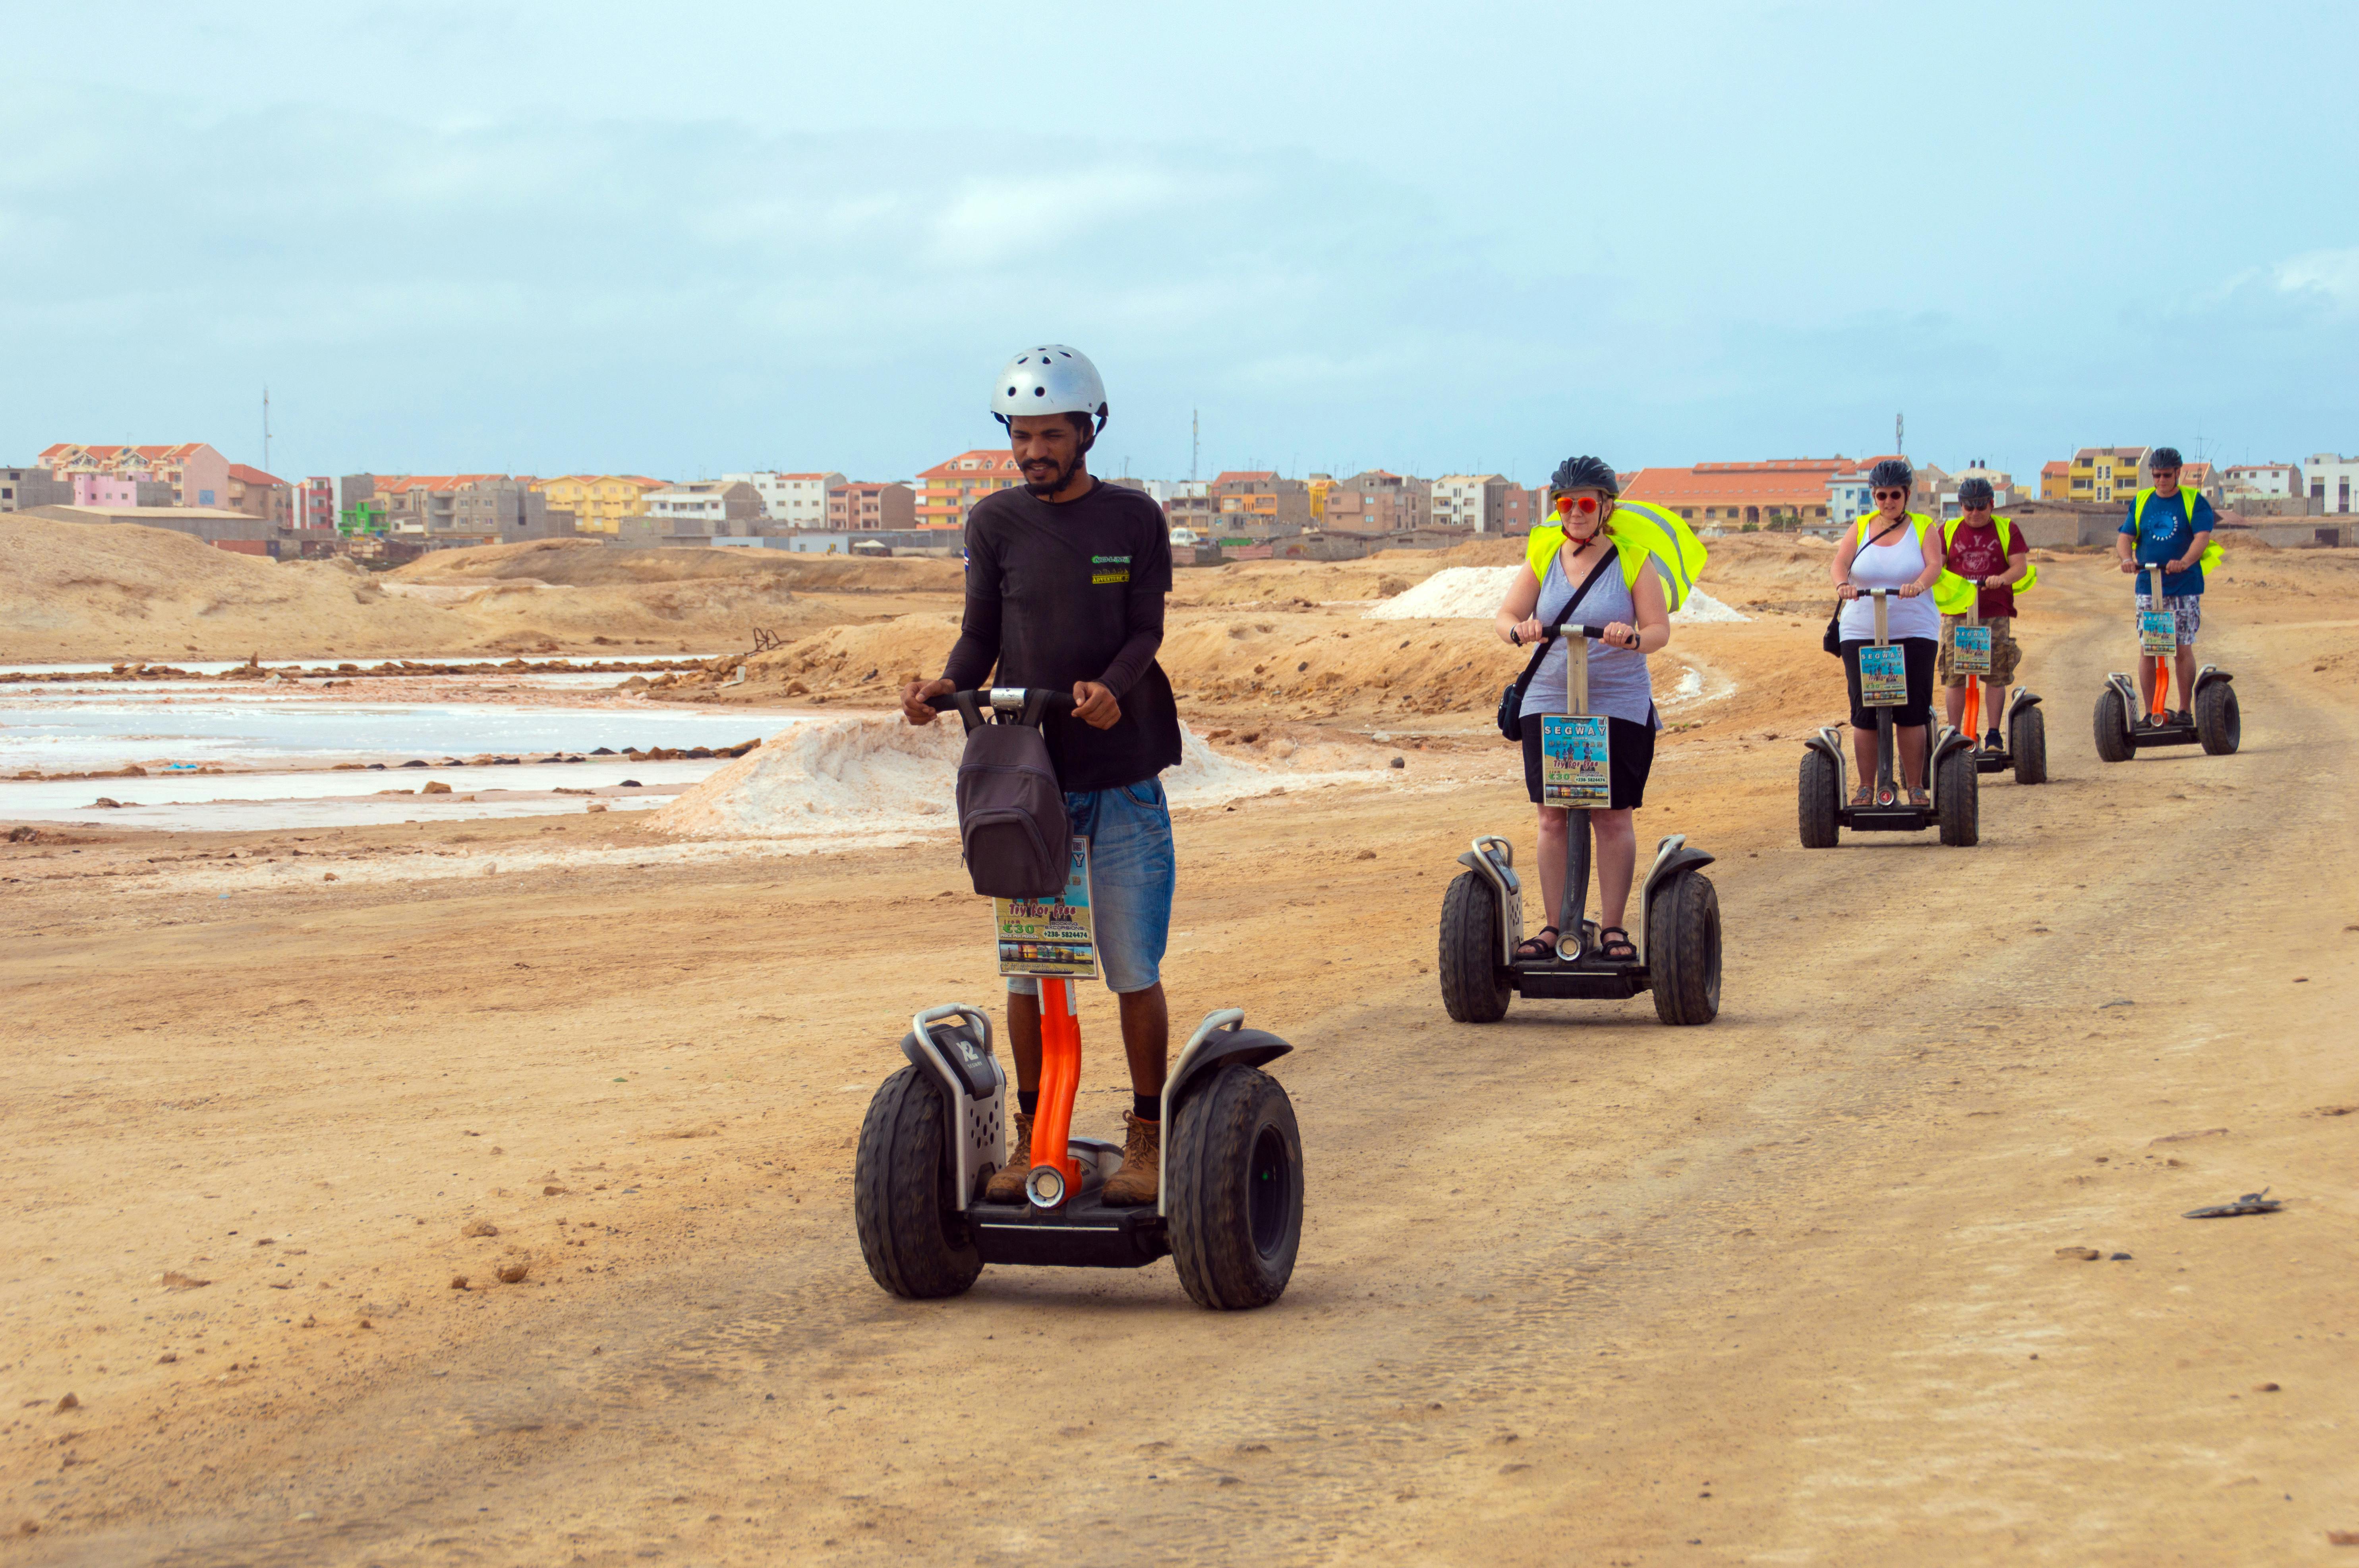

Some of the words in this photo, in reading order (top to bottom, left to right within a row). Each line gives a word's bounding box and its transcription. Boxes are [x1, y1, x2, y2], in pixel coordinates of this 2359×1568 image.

[1544, 726, 1606, 736] SEGWAY
[1553, 760, 1565, 769] Try
[1568, 760, 1580, 769] for
[1582, 760, 1599, 769] free
[1009, 904, 1027, 917] Try
[1031, 904, 1048, 917] for
[1053, 904, 1076, 918] free
[1003, 923, 1034, 934] €30
